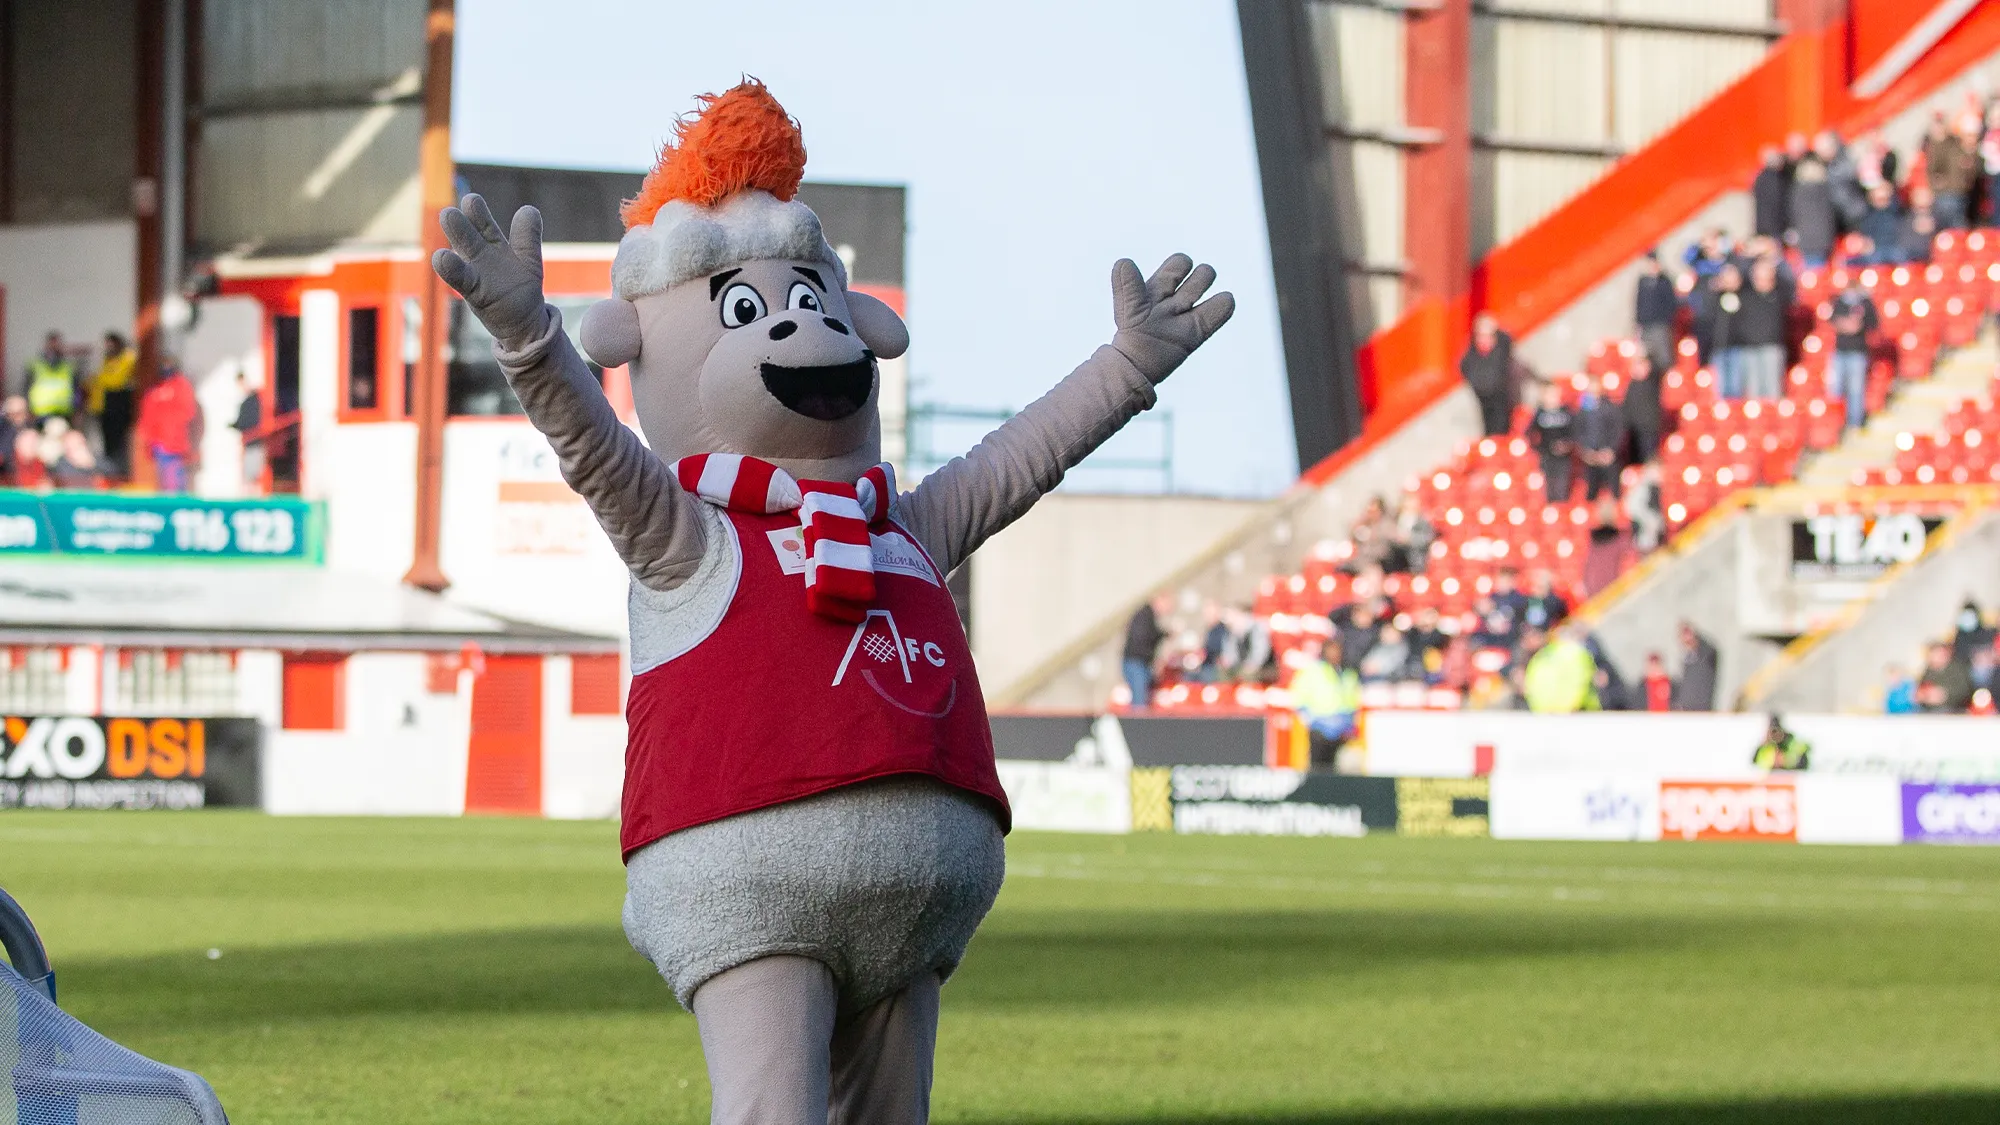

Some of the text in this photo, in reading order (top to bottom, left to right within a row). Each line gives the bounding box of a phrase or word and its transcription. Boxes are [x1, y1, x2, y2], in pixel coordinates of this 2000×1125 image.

[171, 508, 229, 551] 116
[231, 509, 294, 553] 123
[0, 717, 206, 779] XO DSI
[1661, 787, 1795, 839] sports
